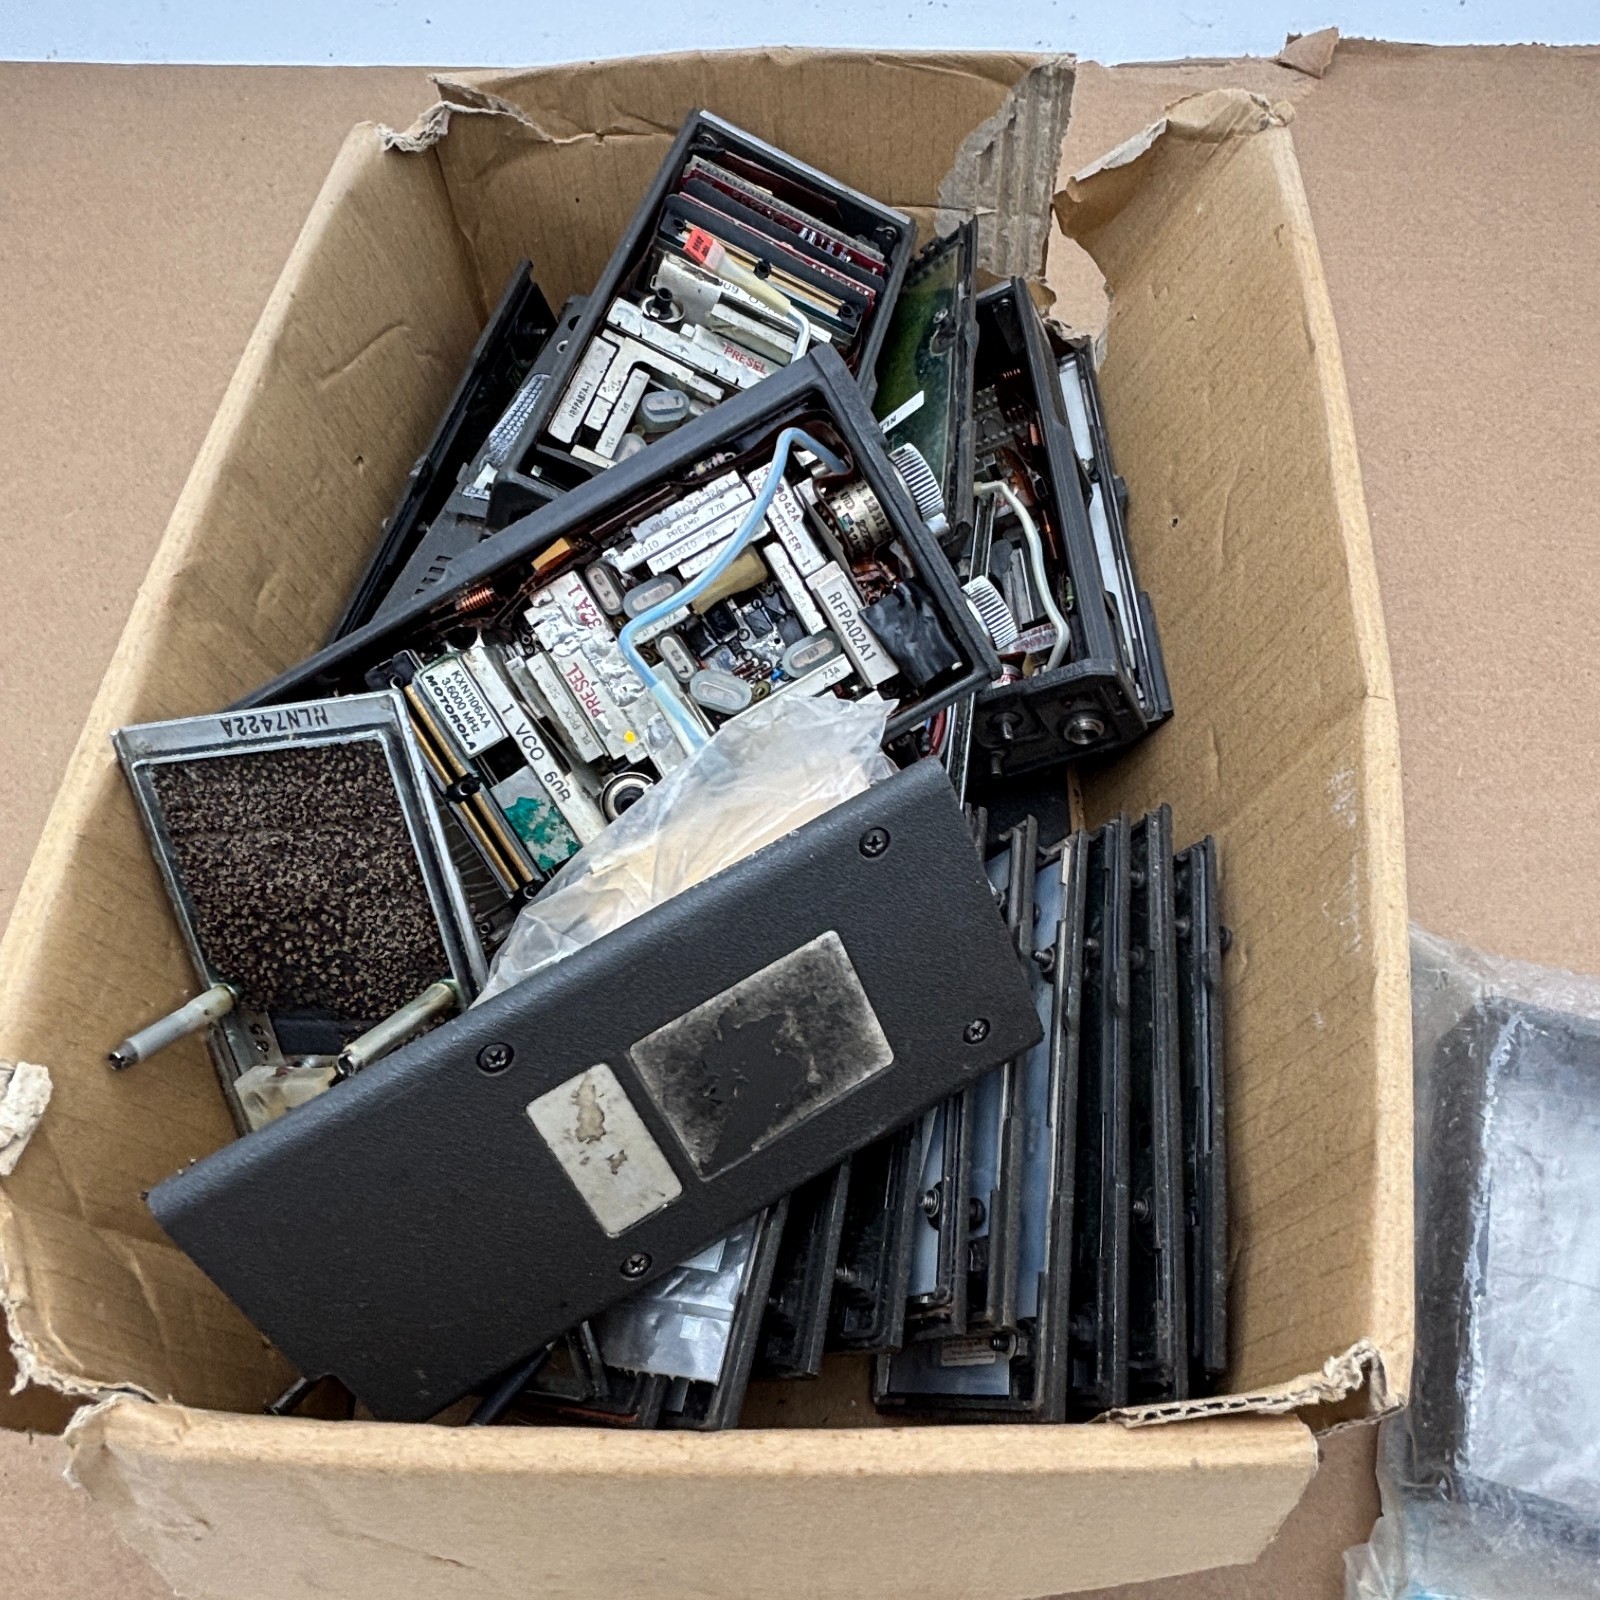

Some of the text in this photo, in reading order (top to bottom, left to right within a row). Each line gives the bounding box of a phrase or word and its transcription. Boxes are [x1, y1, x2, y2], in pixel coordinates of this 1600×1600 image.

[722, 343, 771, 376] PRESEL
[629, 537, 660, 560] AUDIO
[772, 512, 802, 553] FILTER
[827, 590, 877, 663] RFPA02A1
[424, 671, 478, 752] MOTOROLA
[440, 675, 481, 735] 3.6000 MHz
[450, 668, 492, 729] KXN1106AA
[562, 660, 606, 719] PRESEL
[512, 721, 546, 763] VCO
